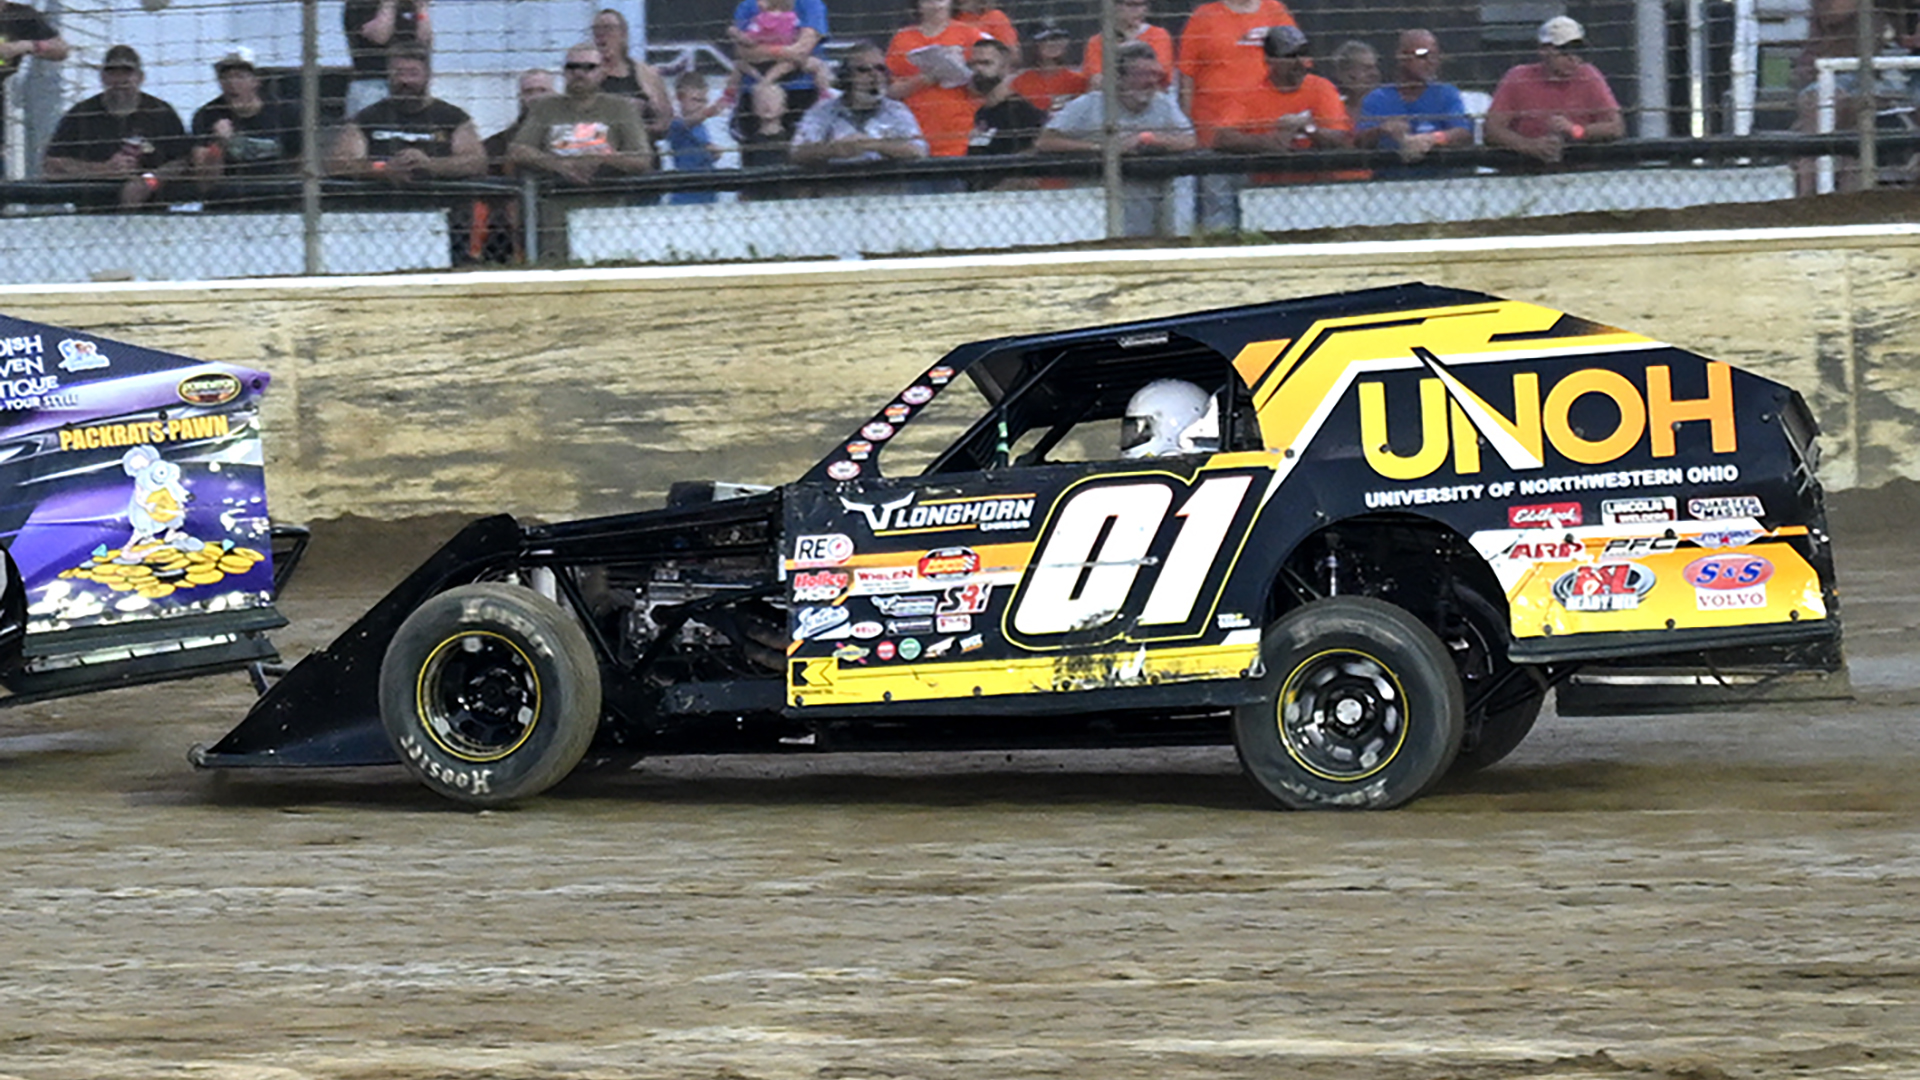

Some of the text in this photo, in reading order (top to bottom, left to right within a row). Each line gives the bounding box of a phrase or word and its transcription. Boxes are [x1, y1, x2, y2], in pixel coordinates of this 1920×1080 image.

[59, 414, 229, 451] PACKRATS PAWN
[1358, 360, 1738, 480] UNOH
[1365, 465, 1738, 508] UNIVERSITY OF NORTHWESTERN OHIO
[895, 499, 1035, 528] LONGHORN
[1014, 476, 1253, 635] 01
[858, 569, 914, 580] WHELEN
[1699, 593, 1763, 607] VOLVO
